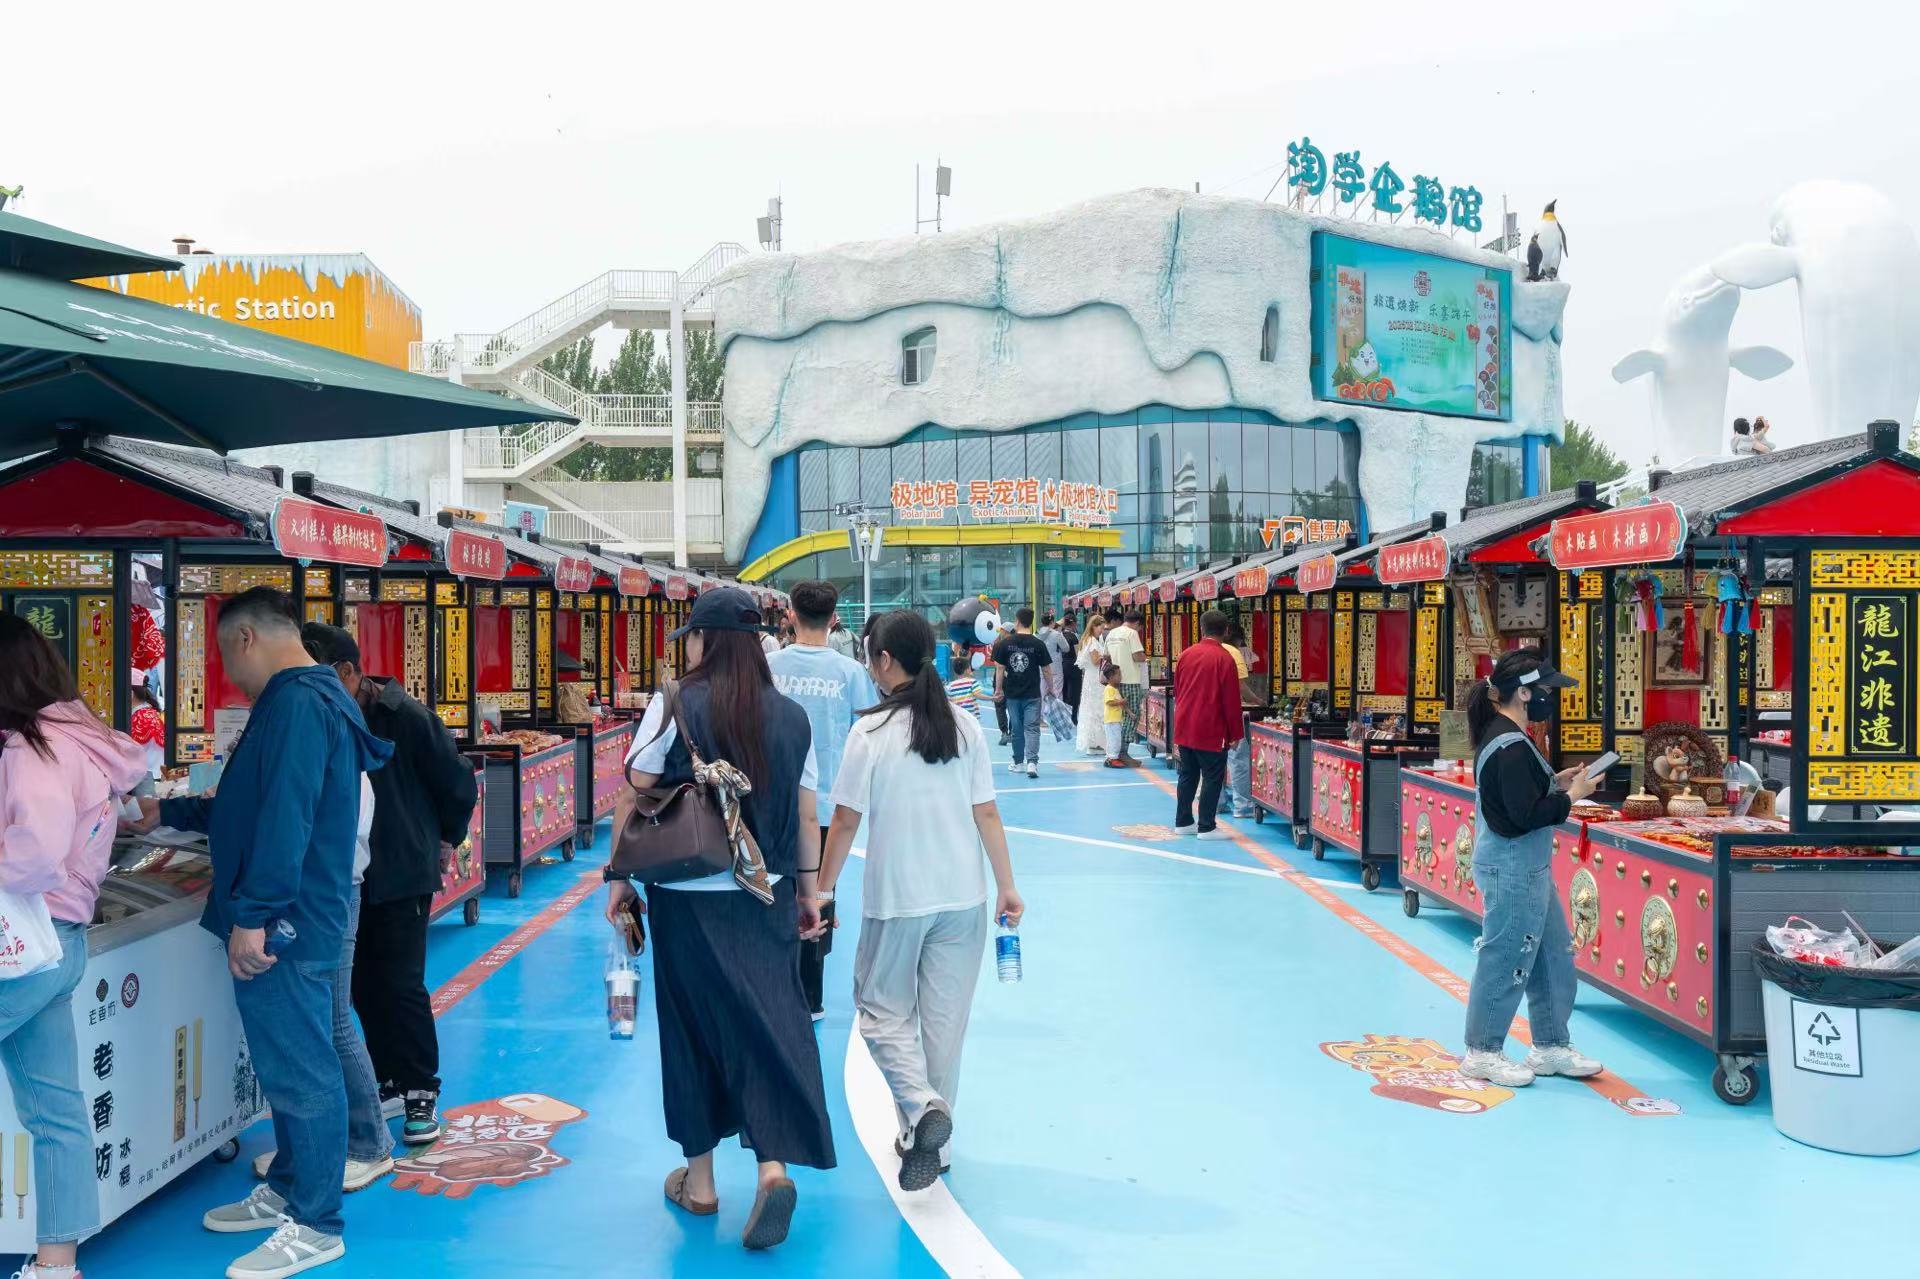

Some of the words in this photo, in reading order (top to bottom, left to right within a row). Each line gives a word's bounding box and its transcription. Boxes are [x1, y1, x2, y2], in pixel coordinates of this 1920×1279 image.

[1287, 136, 1483, 233] 淘学企鹅馆
[235, 295, 336, 320] Station
[891, 480, 957, 507] 极地馆
[968, 476, 1039, 505] 异宠馆
[1060, 481, 1117, 512] 极地馆入口
[901, 508, 942, 518] Polarland
[972, 507, 999, 517] Exotic
[1003, 506, 1035, 516] Animal
[1307, 518, 1352, 542] 售票处
[1803, 1056, 1829, 1067] Residual
[1808, 1049, 1843, 1061] 其他垃圾
